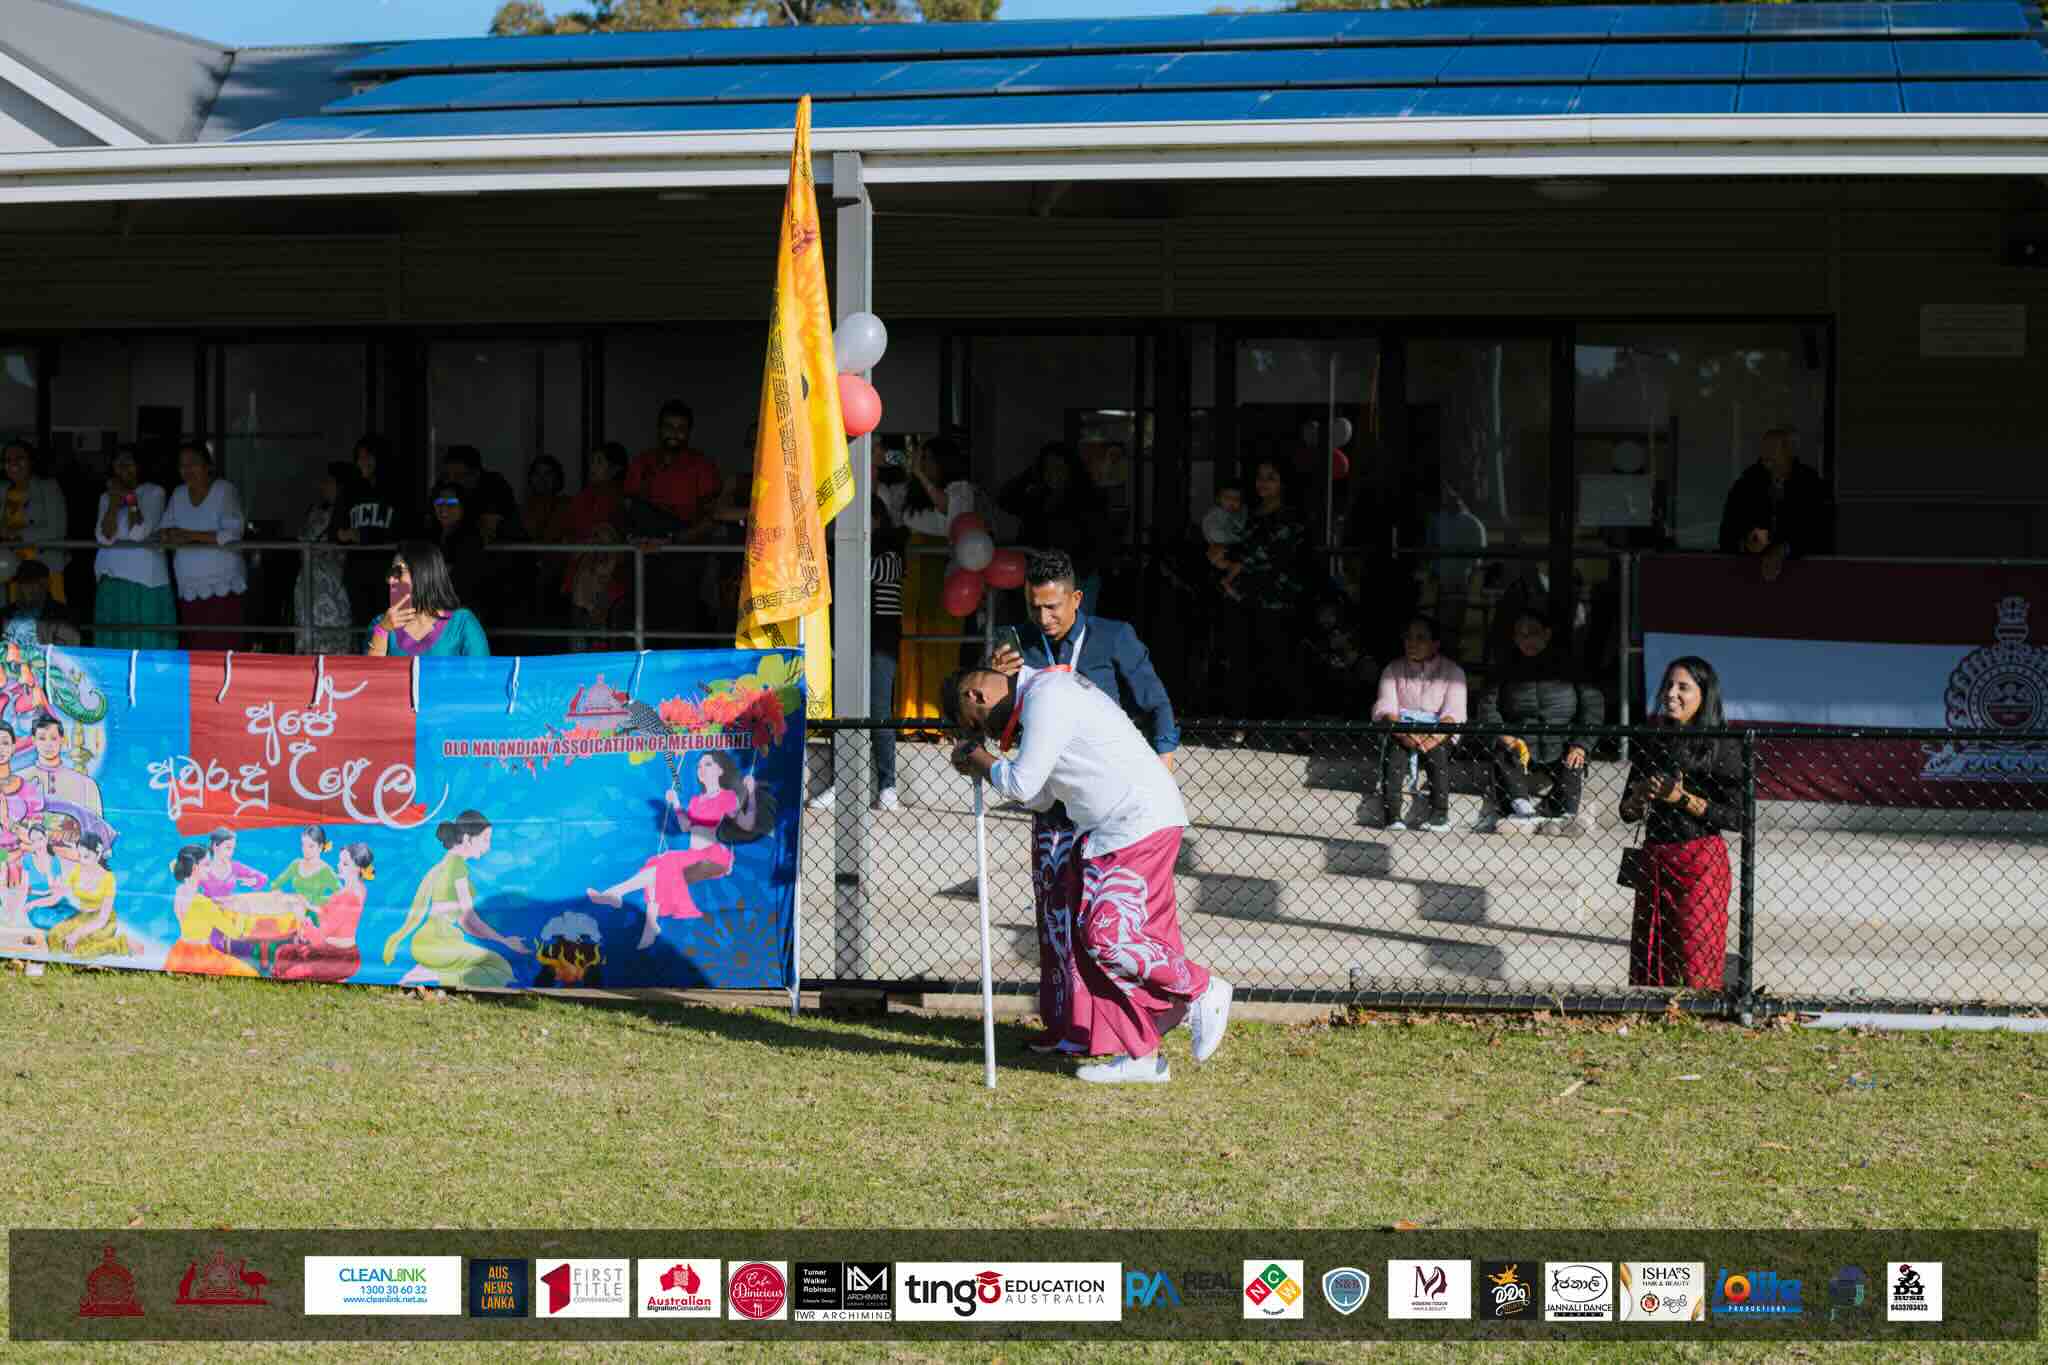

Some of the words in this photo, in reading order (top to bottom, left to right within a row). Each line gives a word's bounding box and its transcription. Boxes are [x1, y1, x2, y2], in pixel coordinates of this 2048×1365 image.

[443, 740, 468, 757] OLD
[471, 738, 549, 758] NALANDIAN
[649, 735, 667, 752] OF
[668, 733, 751, 752] MELBOURNE
